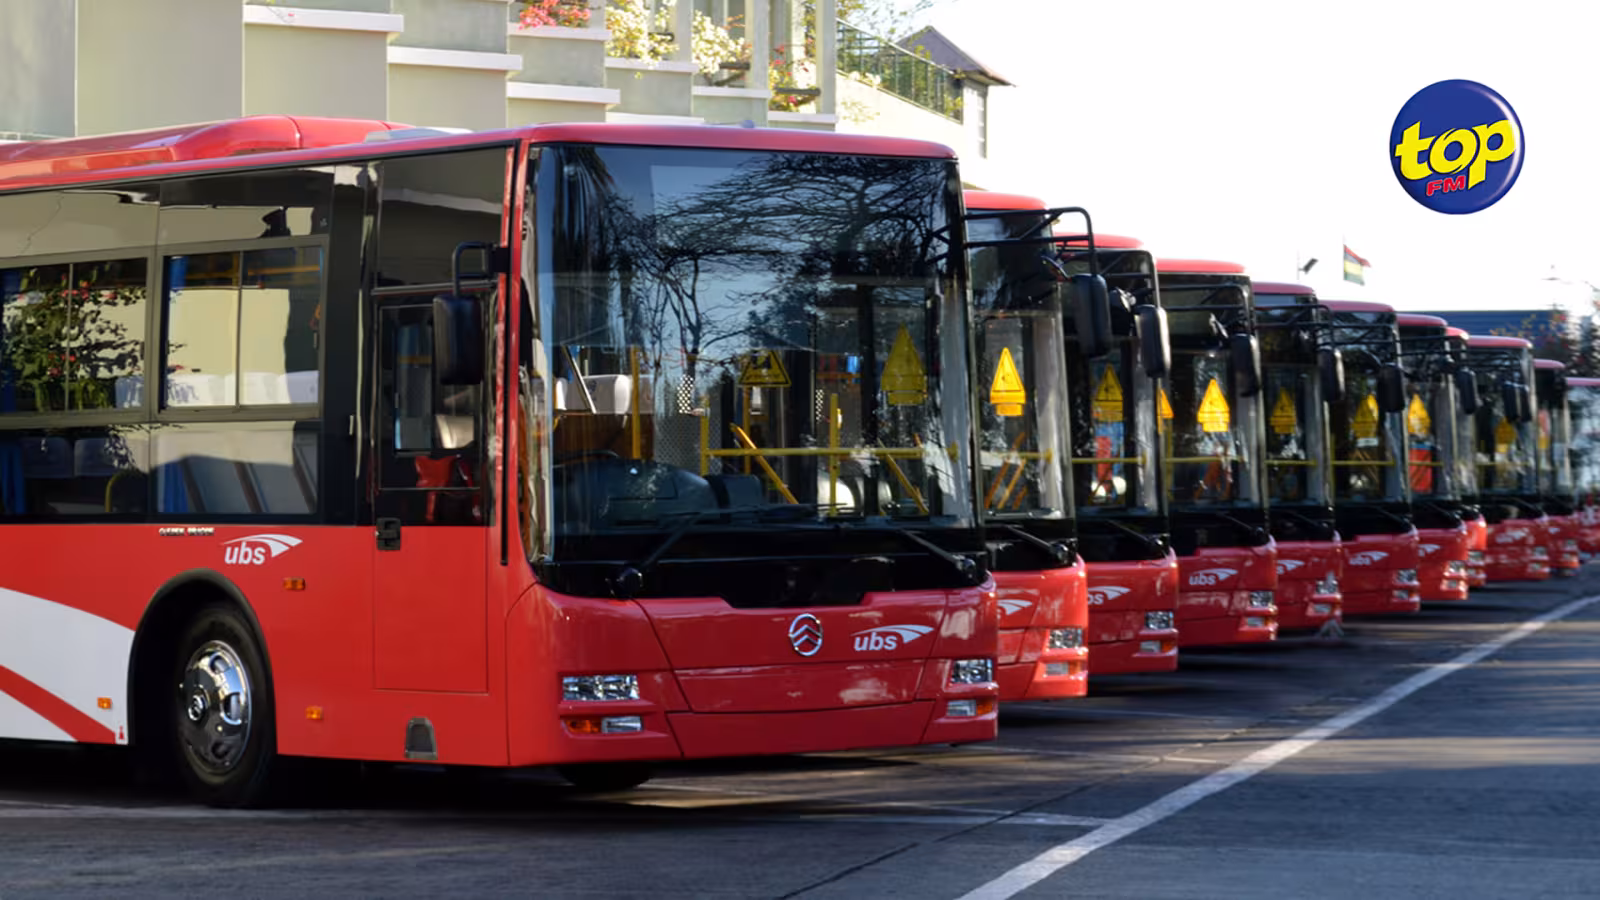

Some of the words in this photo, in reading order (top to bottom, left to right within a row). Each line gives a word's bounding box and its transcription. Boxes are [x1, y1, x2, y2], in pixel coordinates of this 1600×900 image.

[224, 541, 265, 564] ubs
[1189, 571, 1216, 585] ubs
[853, 632, 897, 651] ubs
